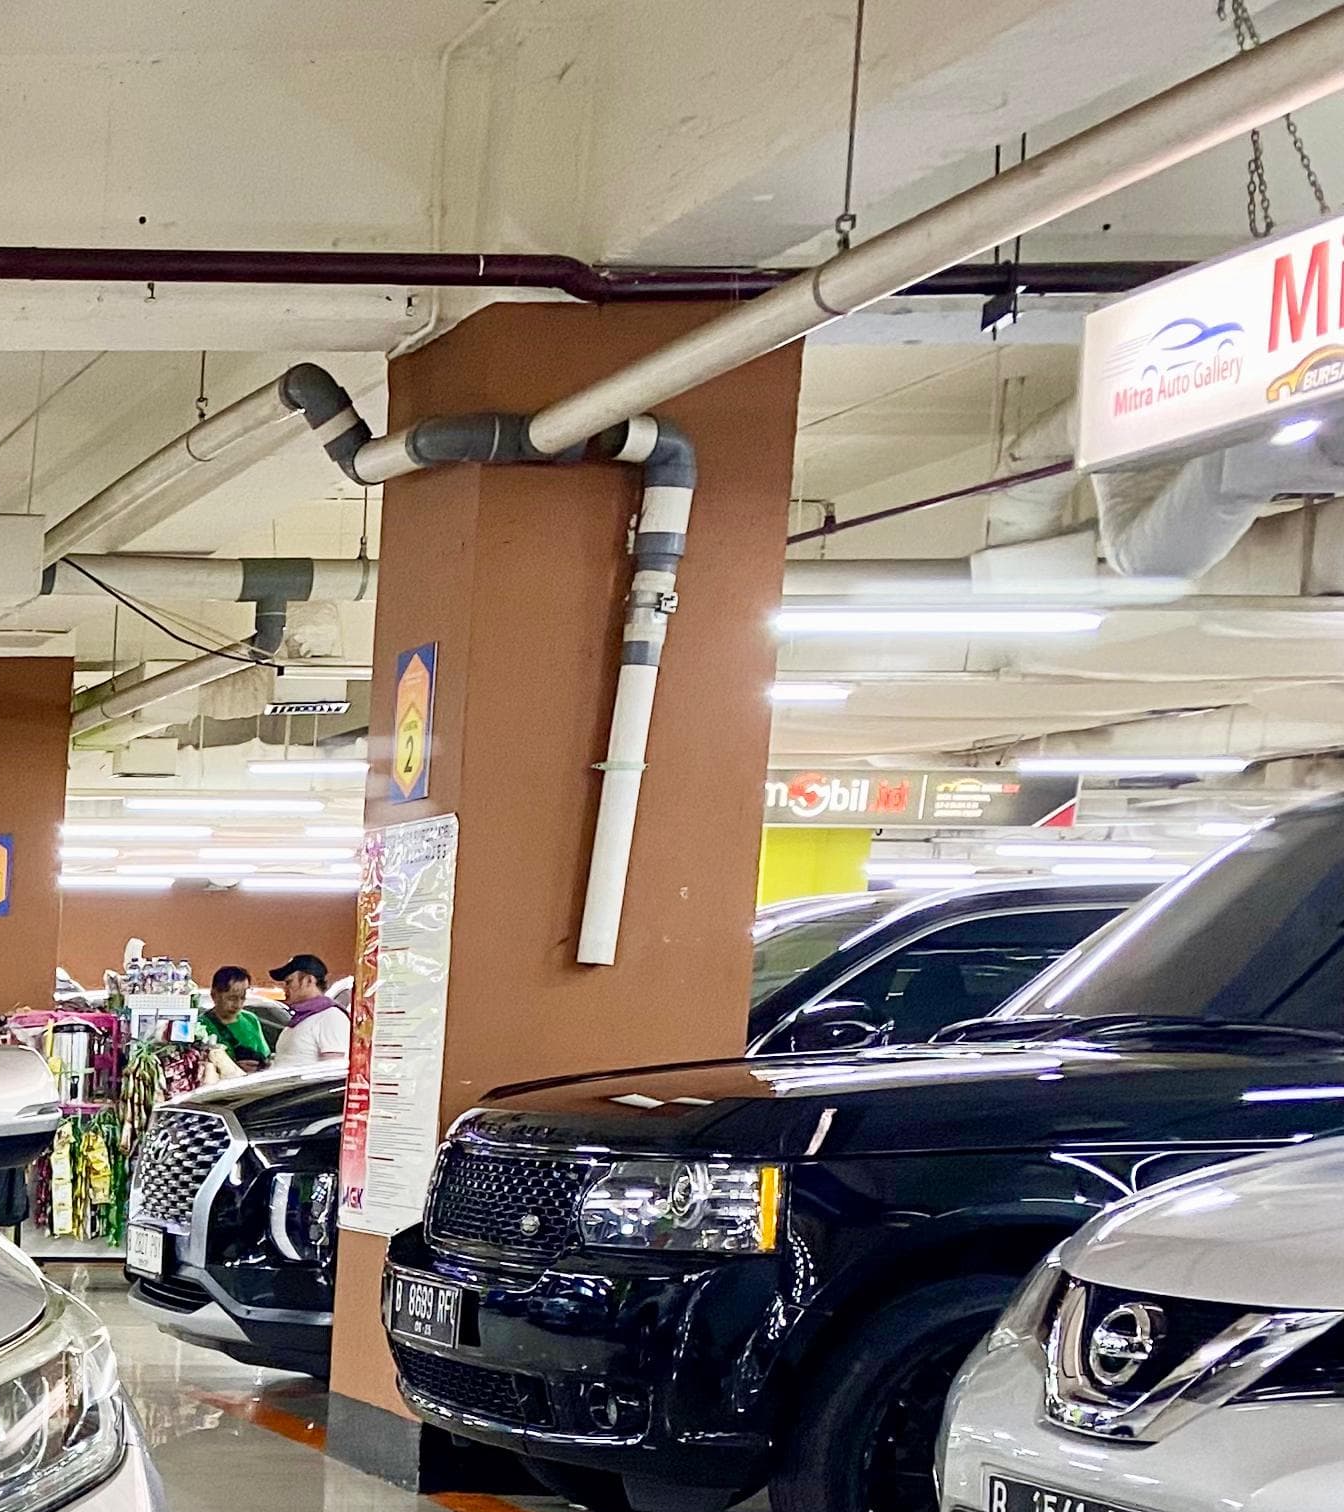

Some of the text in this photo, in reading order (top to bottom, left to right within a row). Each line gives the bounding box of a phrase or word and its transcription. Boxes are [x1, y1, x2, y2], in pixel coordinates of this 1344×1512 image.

[1114, 354, 1243, 417] Mitra Auto Gallery
[403, 735, 415, 774] 2
